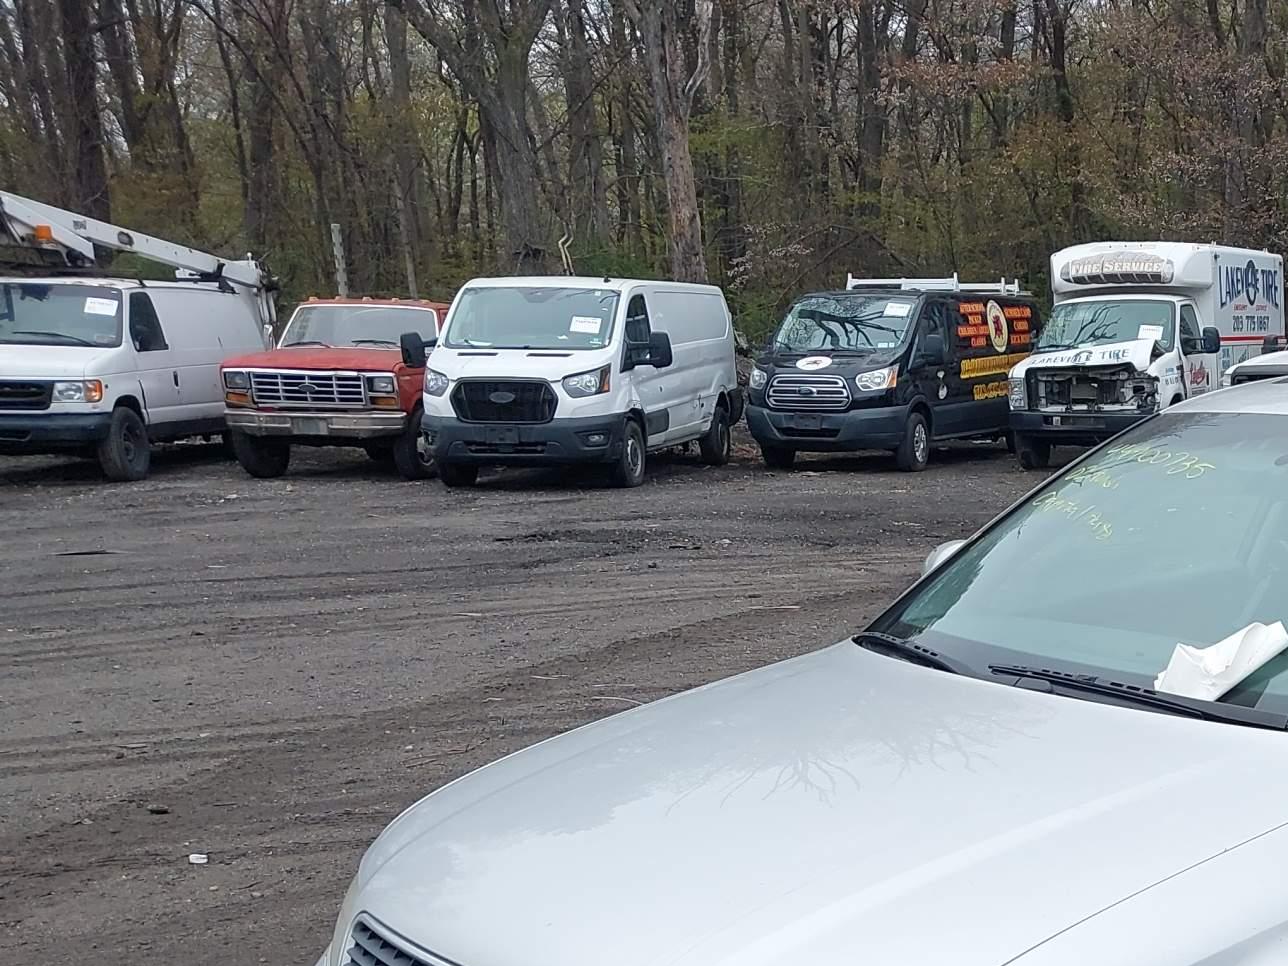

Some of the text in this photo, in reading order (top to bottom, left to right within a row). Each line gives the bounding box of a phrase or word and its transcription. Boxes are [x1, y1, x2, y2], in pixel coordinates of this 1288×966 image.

[1103, 261, 1161, 272] SERVICE
[1260, 268, 1279, 310] TIRE
[1232, 315, 1270, 332] 203 775 1867
[1099, 348, 1130, 361] TIRE
